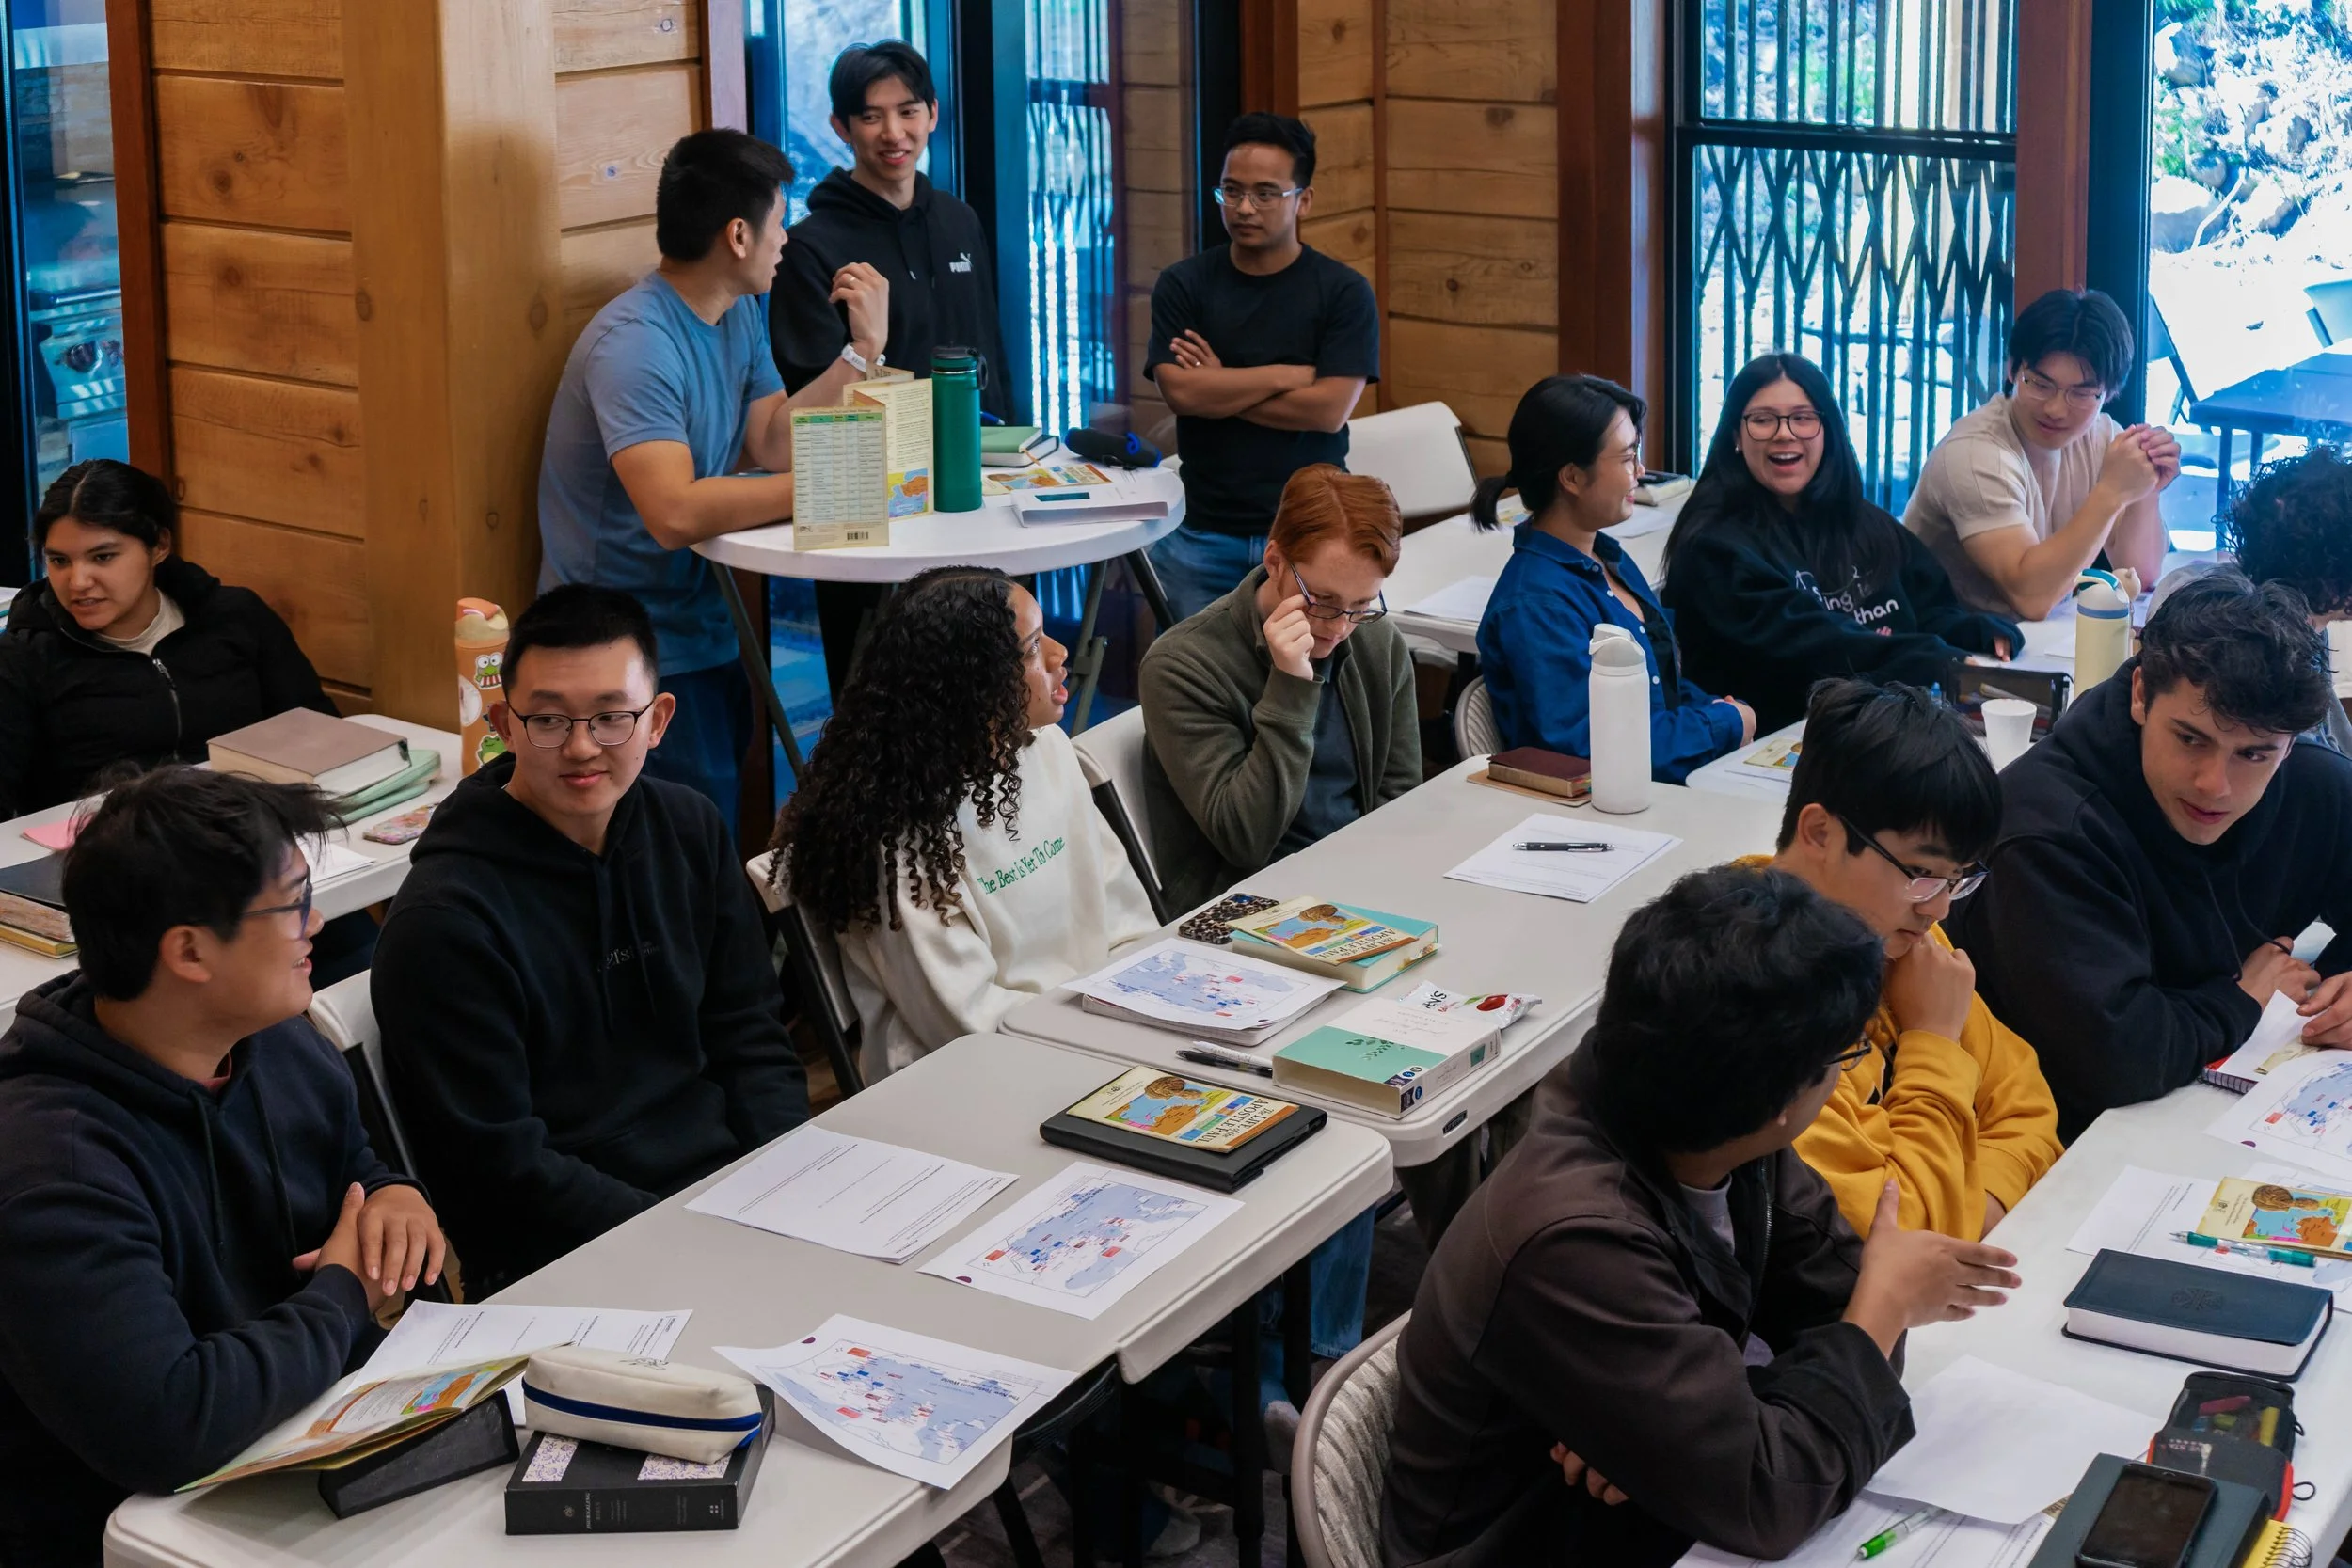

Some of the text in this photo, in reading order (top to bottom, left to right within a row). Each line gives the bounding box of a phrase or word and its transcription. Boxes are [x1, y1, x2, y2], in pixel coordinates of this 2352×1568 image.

[1853, 599, 1899, 625] than
[977, 837, 1065, 895] The Best is Yet To Come
[1195, 1098, 1269, 1143] APOSTLE PAUL
[1240, 1114, 1266, 1130] LIFE
[1258, 1107, 1275, 1116] The
